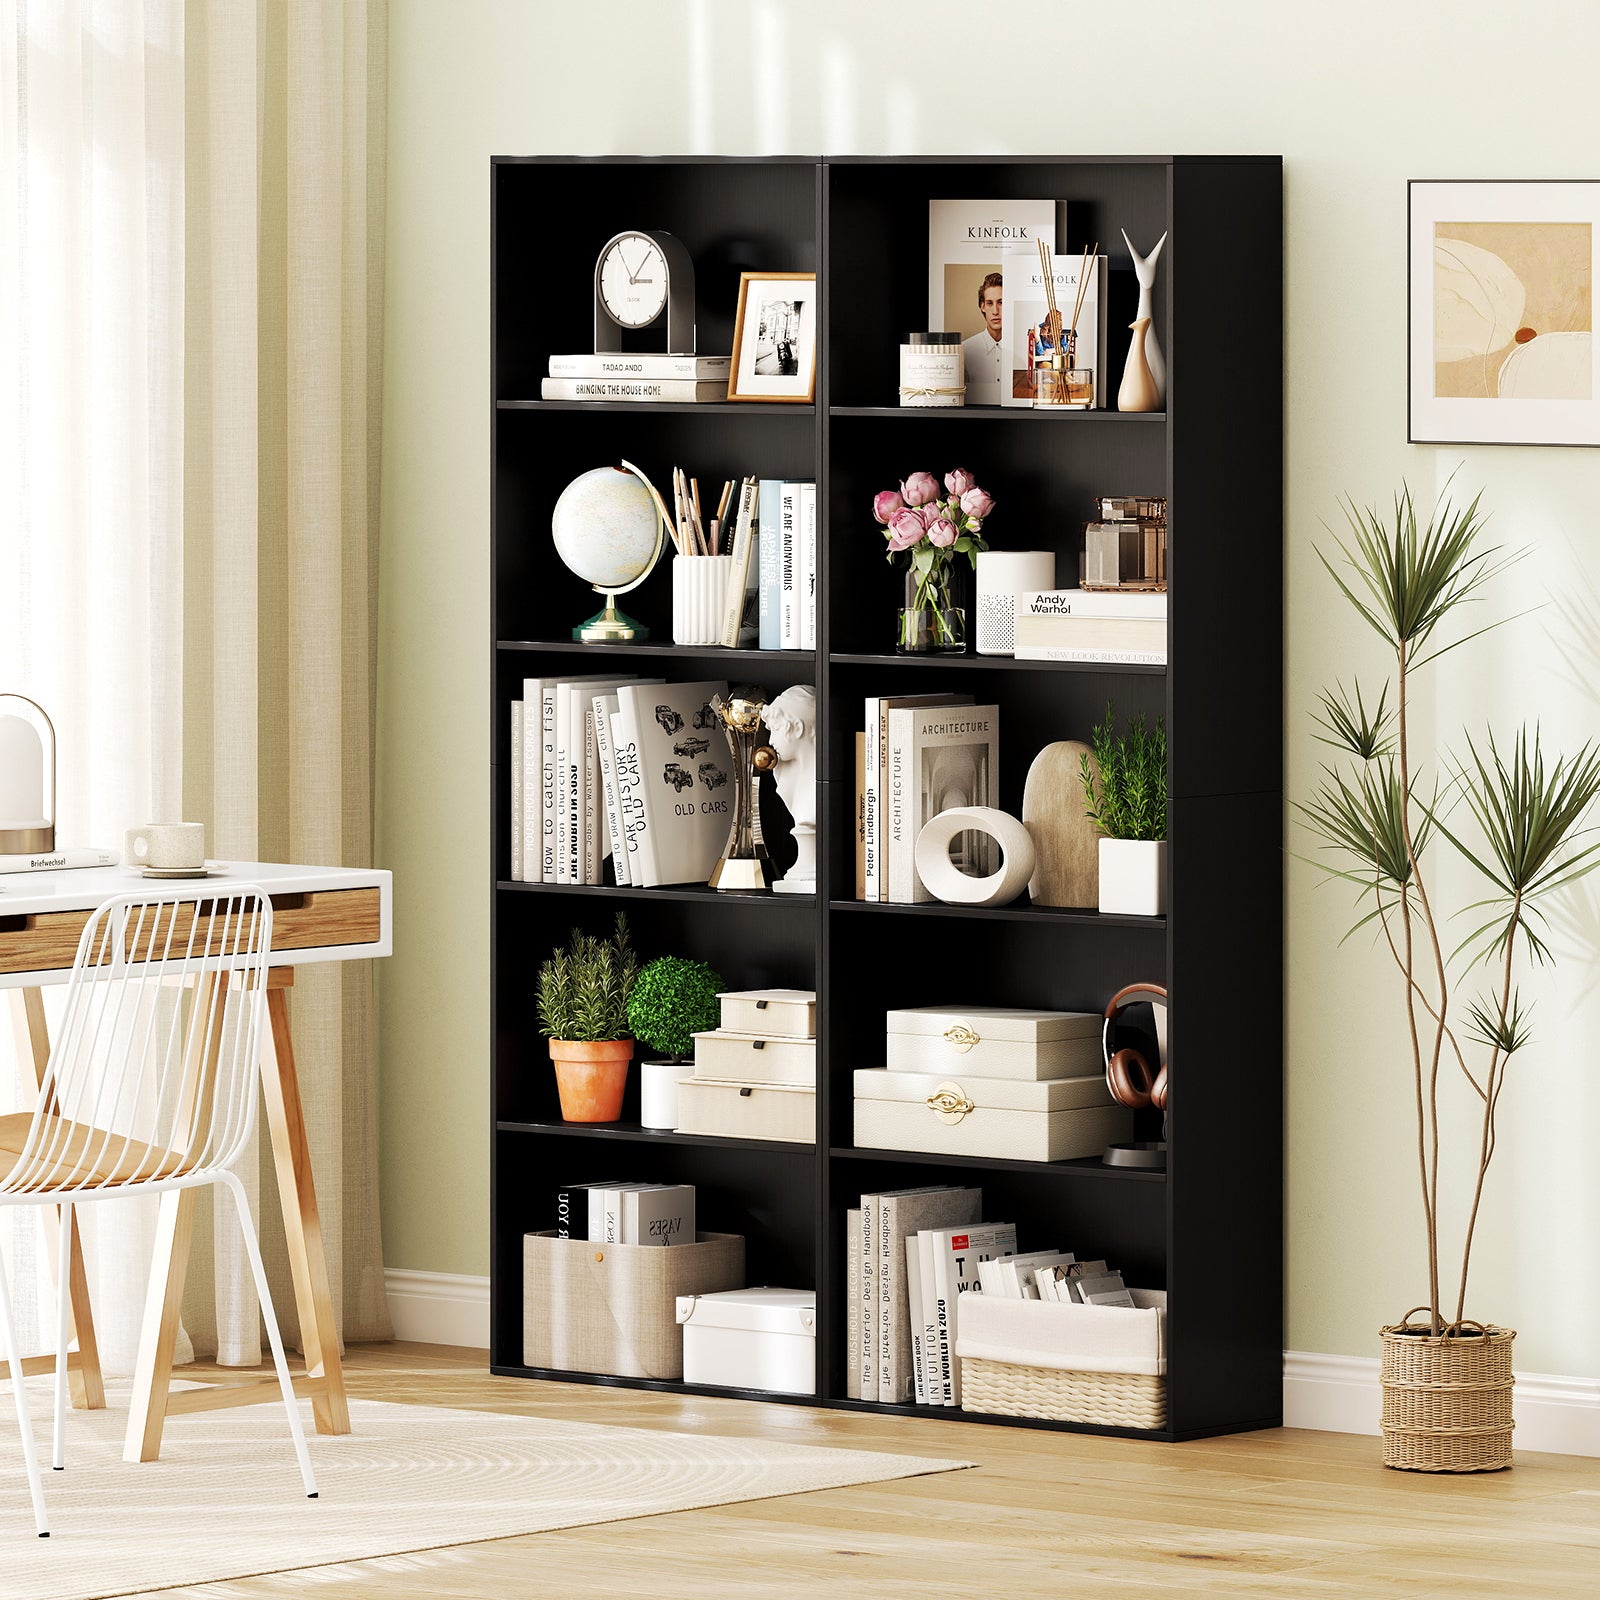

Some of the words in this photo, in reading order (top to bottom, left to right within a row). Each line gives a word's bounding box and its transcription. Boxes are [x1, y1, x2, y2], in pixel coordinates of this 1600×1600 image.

[967, 226, 1028, 239] KINFOLK
[602, 363, 623, 372] TADAO
[624, 363, 643, 372] ANDO
[575, 384, 606, 395] BRINGING
[607, 384, 620, 395] THE
[621, 385, 642, 395] HOUSE
[643, 385, 661, 396] HOME
[784, 496, 792, 511] WE
[784, 512, 792, 531] ARE
[767, 526, 776, 586] JAPANESE
[784, 533, 792, 591] ANONYMOUS
[760, 525, 768, 617] ARCHITECTURE
[1030, 604, 1071, 614] Warhol
[1035, 594, 1066, 606] Andy
[1047, 650, 1070, 659] NEW
[1071, 652, 1098, 661] LOOK
[1101, 653, 1165, 663] REVOLUTION
[543, 697, 553, 733] fish
[595, 701, 607, 751] children
[922, 721, 989, 736] ARCHITECTURE
[525, 705, 535, 775] DECORATES
[545, 744, 553, 753] a
[626, 742, 641, 786] CARS
[543, 762, 553, 809] catch
[607, 781, 615, 807] Book
[616, 746, 634, 814] HISTORY
[893, 747, 902, 842] ARCHITECTURE
[525, 782, 535, 851] HOUSEHOLD
[586, 806, 594, 817] by
[635, 798, 647, 832] OLD
[674, 803, 695, 817] OLD
[701, 800, 728, 815] CARS
[866, 788, 877, 845] Lindbergh
[543, 818, 553, 836] to
[609, 812, 619, 837] DRAW
[626, 822, 639, 853] CAR
[30, 857, 66, 868] Briefwechsel
[543, 846, 553, 875] How
[612, 843, 621, 855] TO
[866, 849, 875, 877] Peter
[614, 860, 624, 881] HOW
[863, 1204, 871, 1256] Handbook
[850, 1235, 858, 1300] DECORATES
[863, 1261, 873, 1301] Design
[937, 1299, 947, 1328] 2020
[850, 1304, 858, 1370] HOUSEHOLD
[863, 1307, 871, 1358] Interior
[939, 1329, 948, 1342] IN
[863, 1365, 871, 1384] The
[925, 1324, 940, 1400] INTUITION
[940, 1342, 950, 1380] WORLD
[942, 1382, 952, 1401] THE
